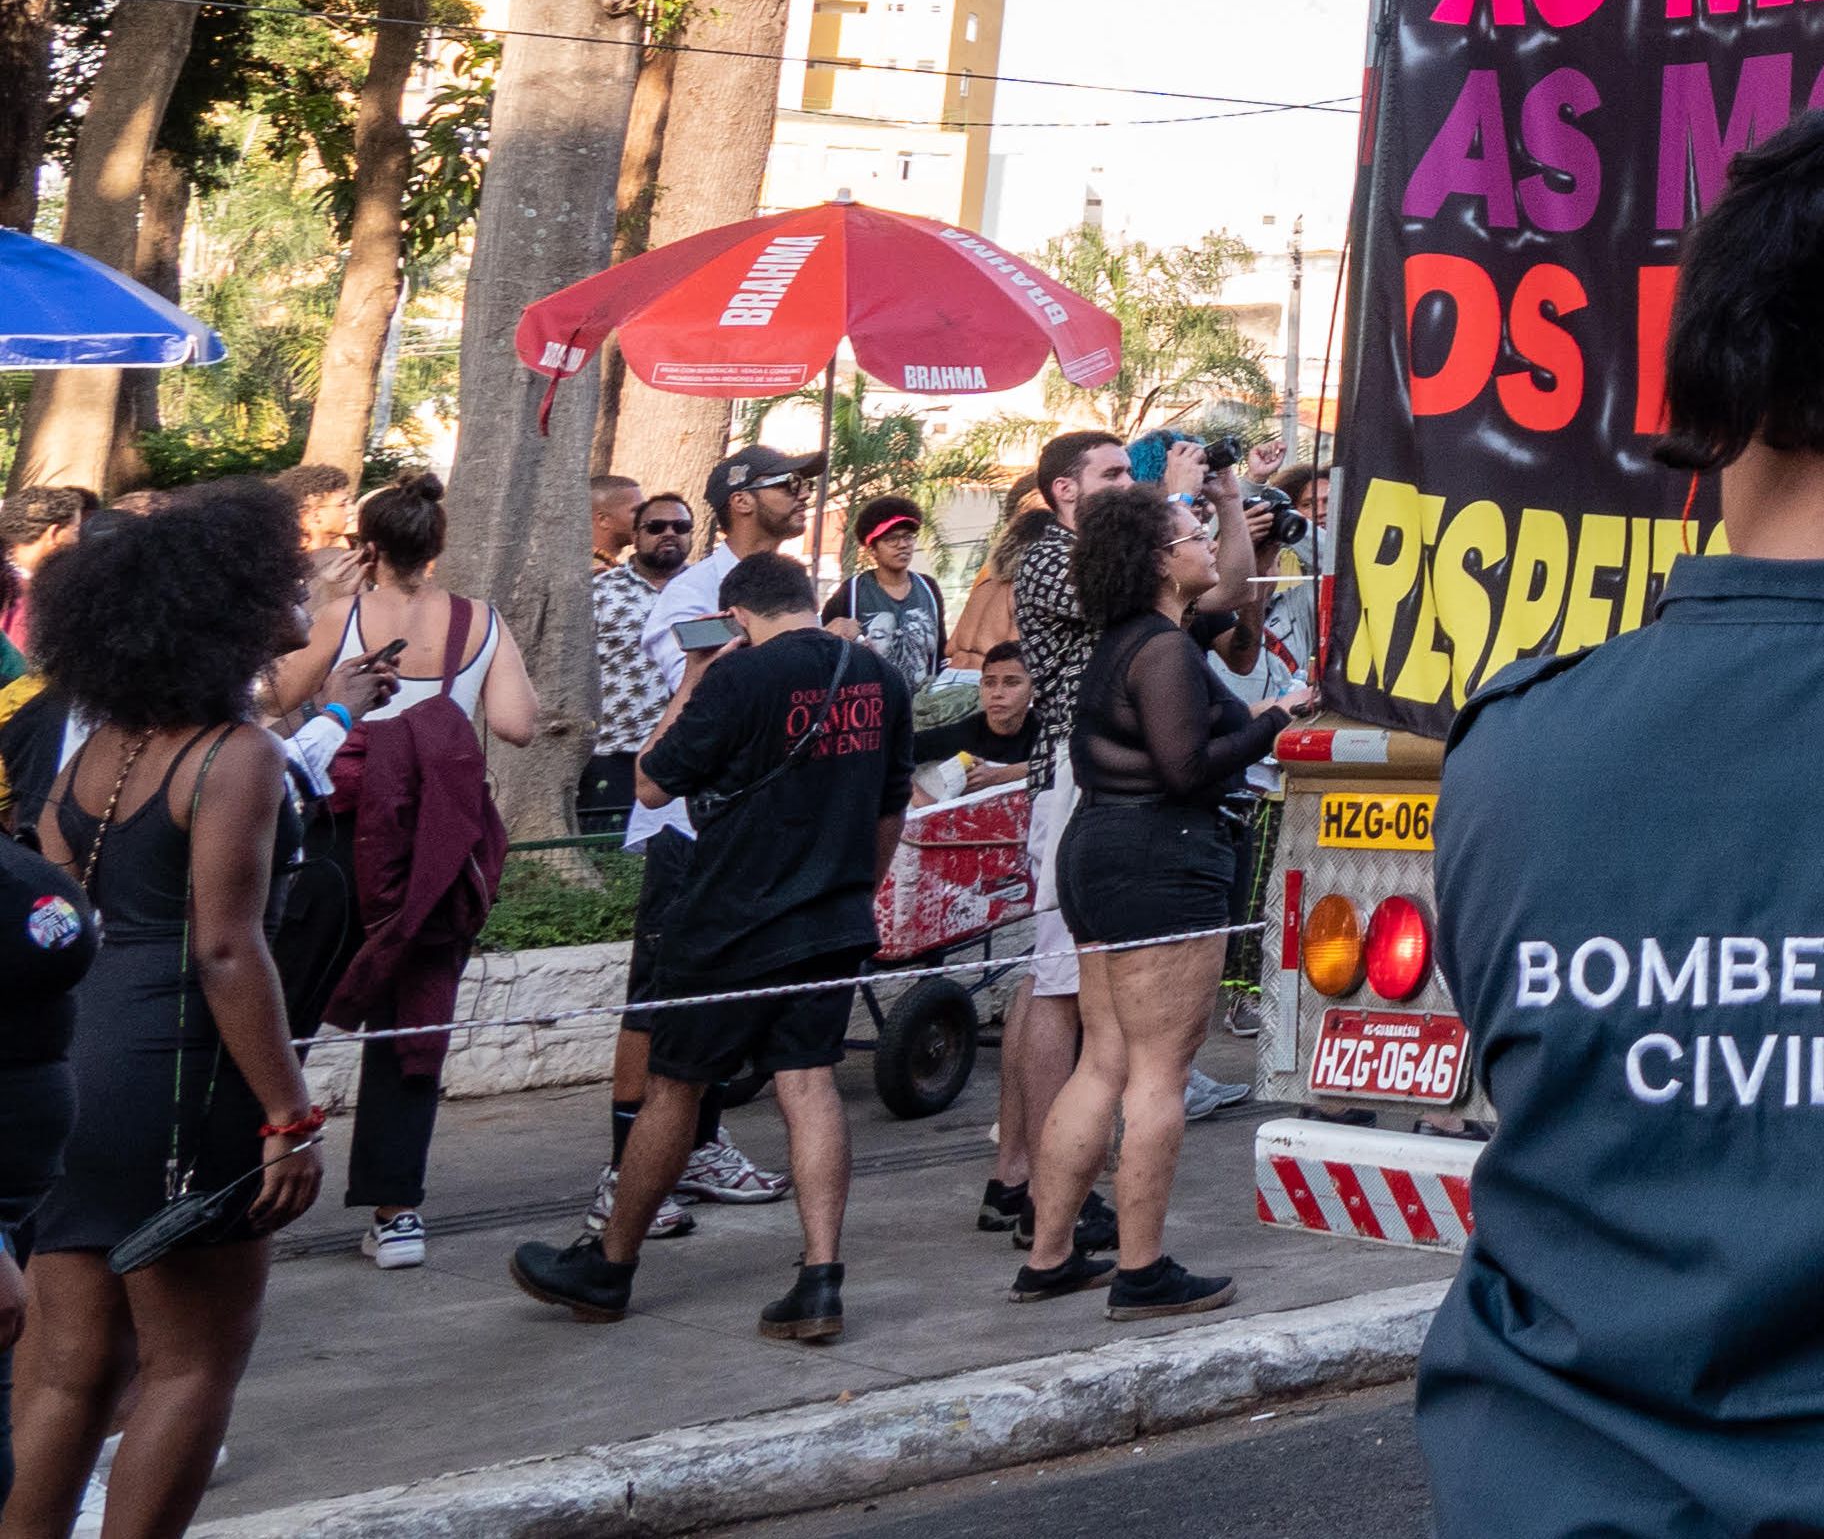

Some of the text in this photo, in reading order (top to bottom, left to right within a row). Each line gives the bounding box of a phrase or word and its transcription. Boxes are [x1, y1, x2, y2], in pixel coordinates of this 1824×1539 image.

[1400, 67, 1602, 233] AS
[719, 235, 824, 327] BRAHMA
[940, 228, 1069, 326] BRAHMA
[904, 365, 987, 390] BRAHMA
[1405, 254, 1587, 430] OS
[786, 697, 884, 737] O MOR
[1324, 801, 1430, 840] HZG-06
[1315, 1037, 1457, 1094] HZG-0646
